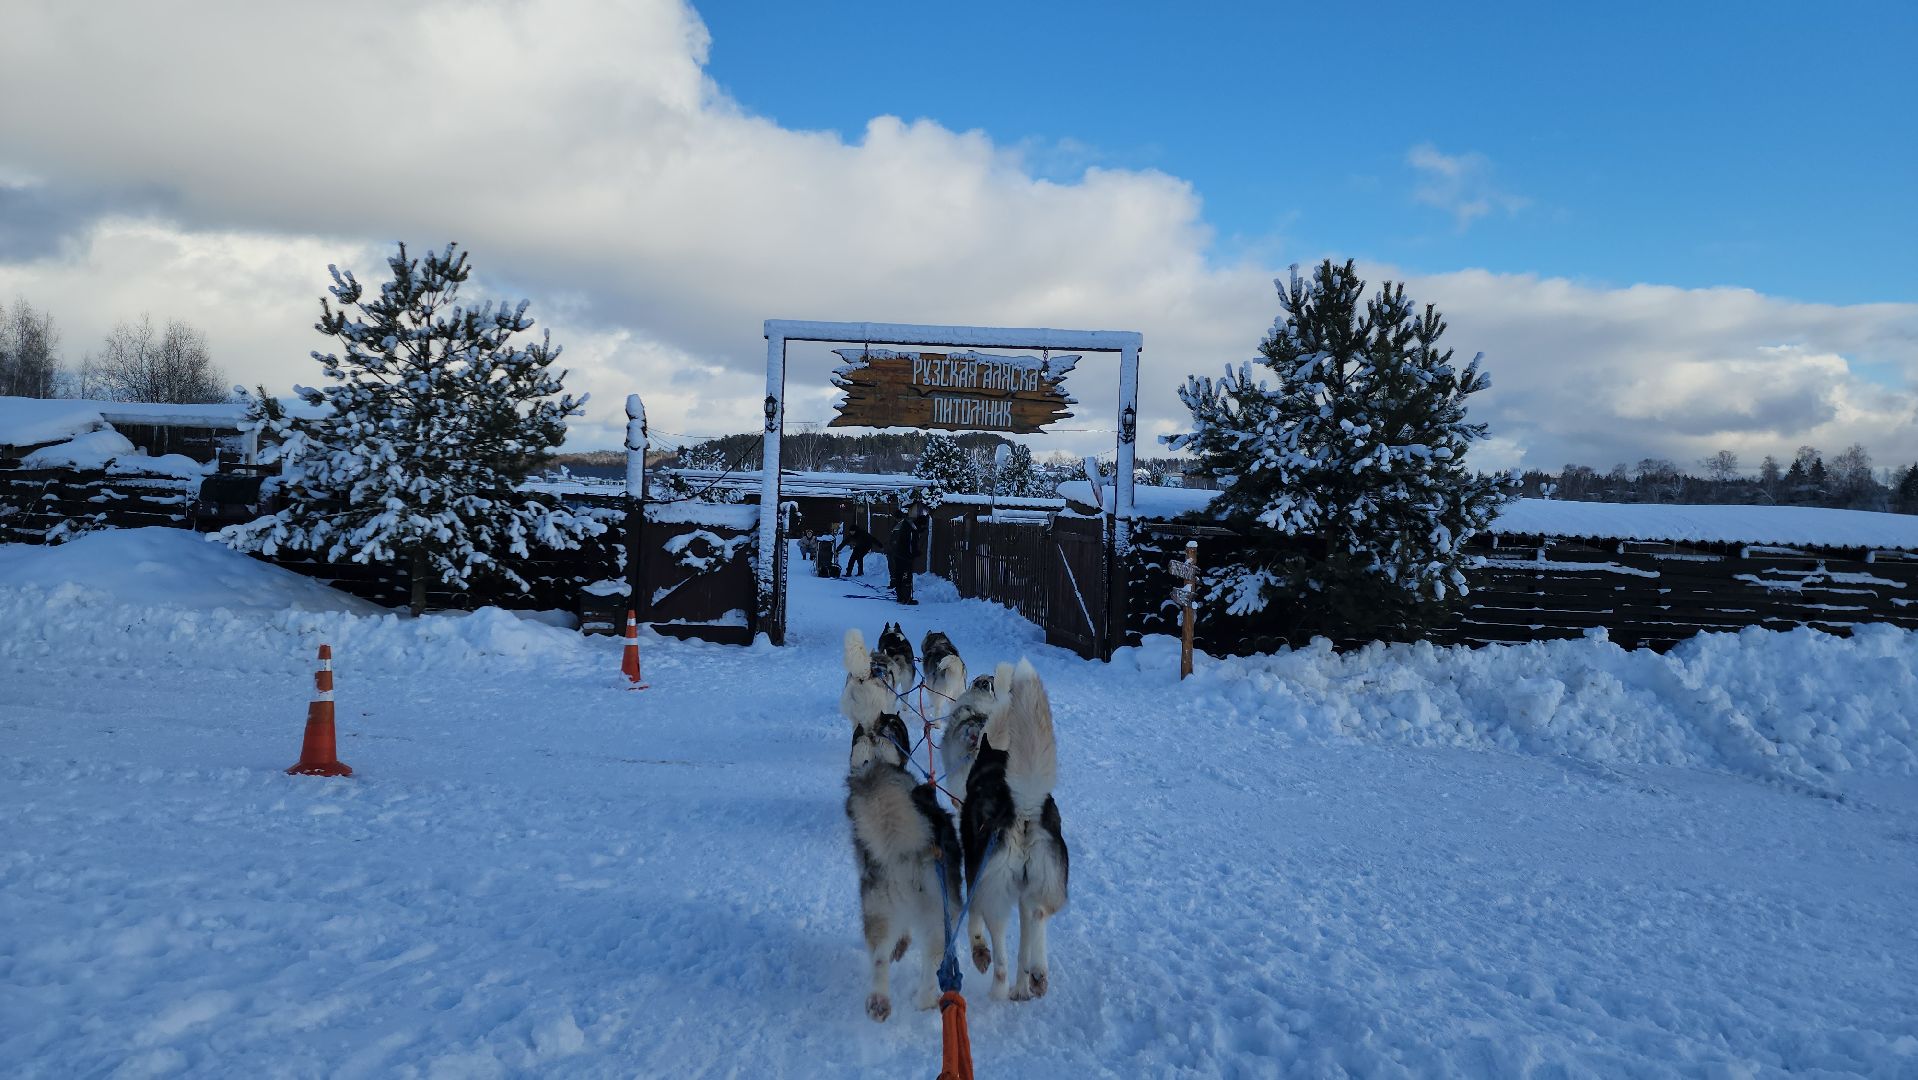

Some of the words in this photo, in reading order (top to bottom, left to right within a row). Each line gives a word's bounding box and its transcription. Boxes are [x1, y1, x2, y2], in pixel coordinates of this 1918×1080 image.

[912, 359, 978, 388] РУЗСКАЯ
[982, 360, 1039, 392] АЛЯСКА
[934, 397, 1013, 427] ПИТОМНИК
